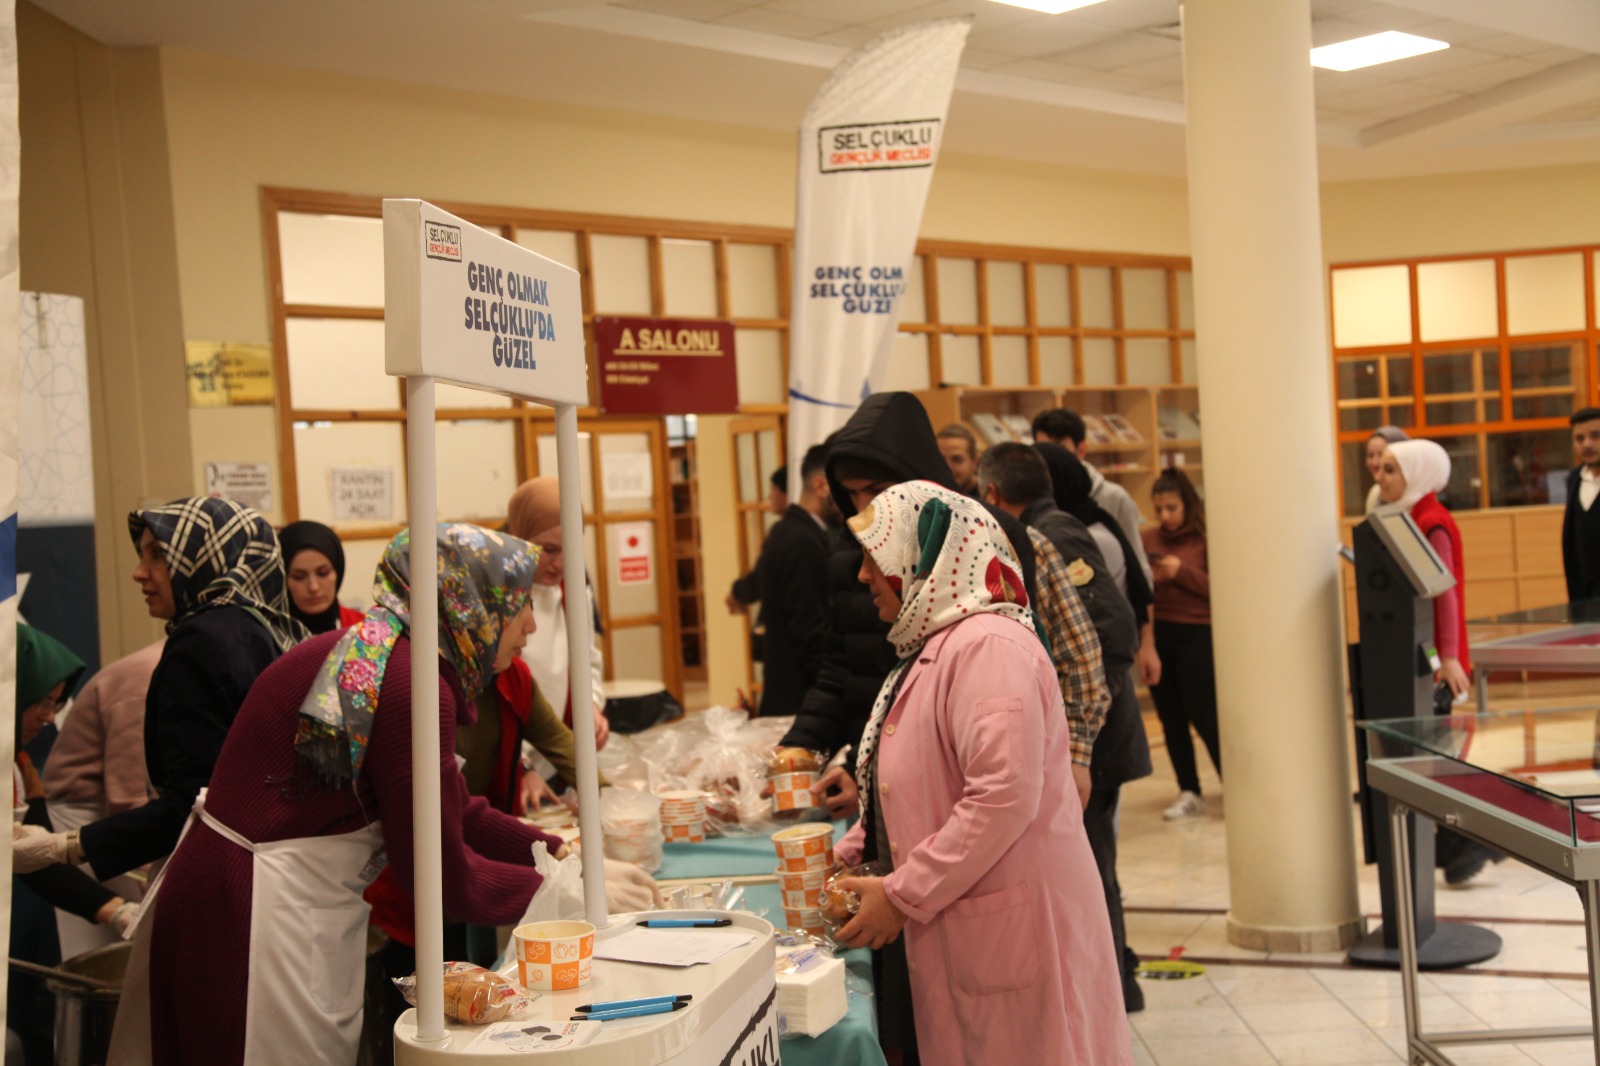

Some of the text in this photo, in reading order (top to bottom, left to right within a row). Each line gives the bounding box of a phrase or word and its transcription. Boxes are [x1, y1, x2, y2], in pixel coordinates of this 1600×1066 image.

[834, 127, 931, 150] SELÇUKLU
[430, 228, 459, 245] SELÇUKLU
[468, 261, 549, 306] GENÇ OLMAK
[815, 266, 862, 282] GENÇ
[465, 296, 555, 341] SELÇUKLU'DA
[619, 328, 720, 351] A SALONU
[493, 335, 536, 370] GÜZEL
